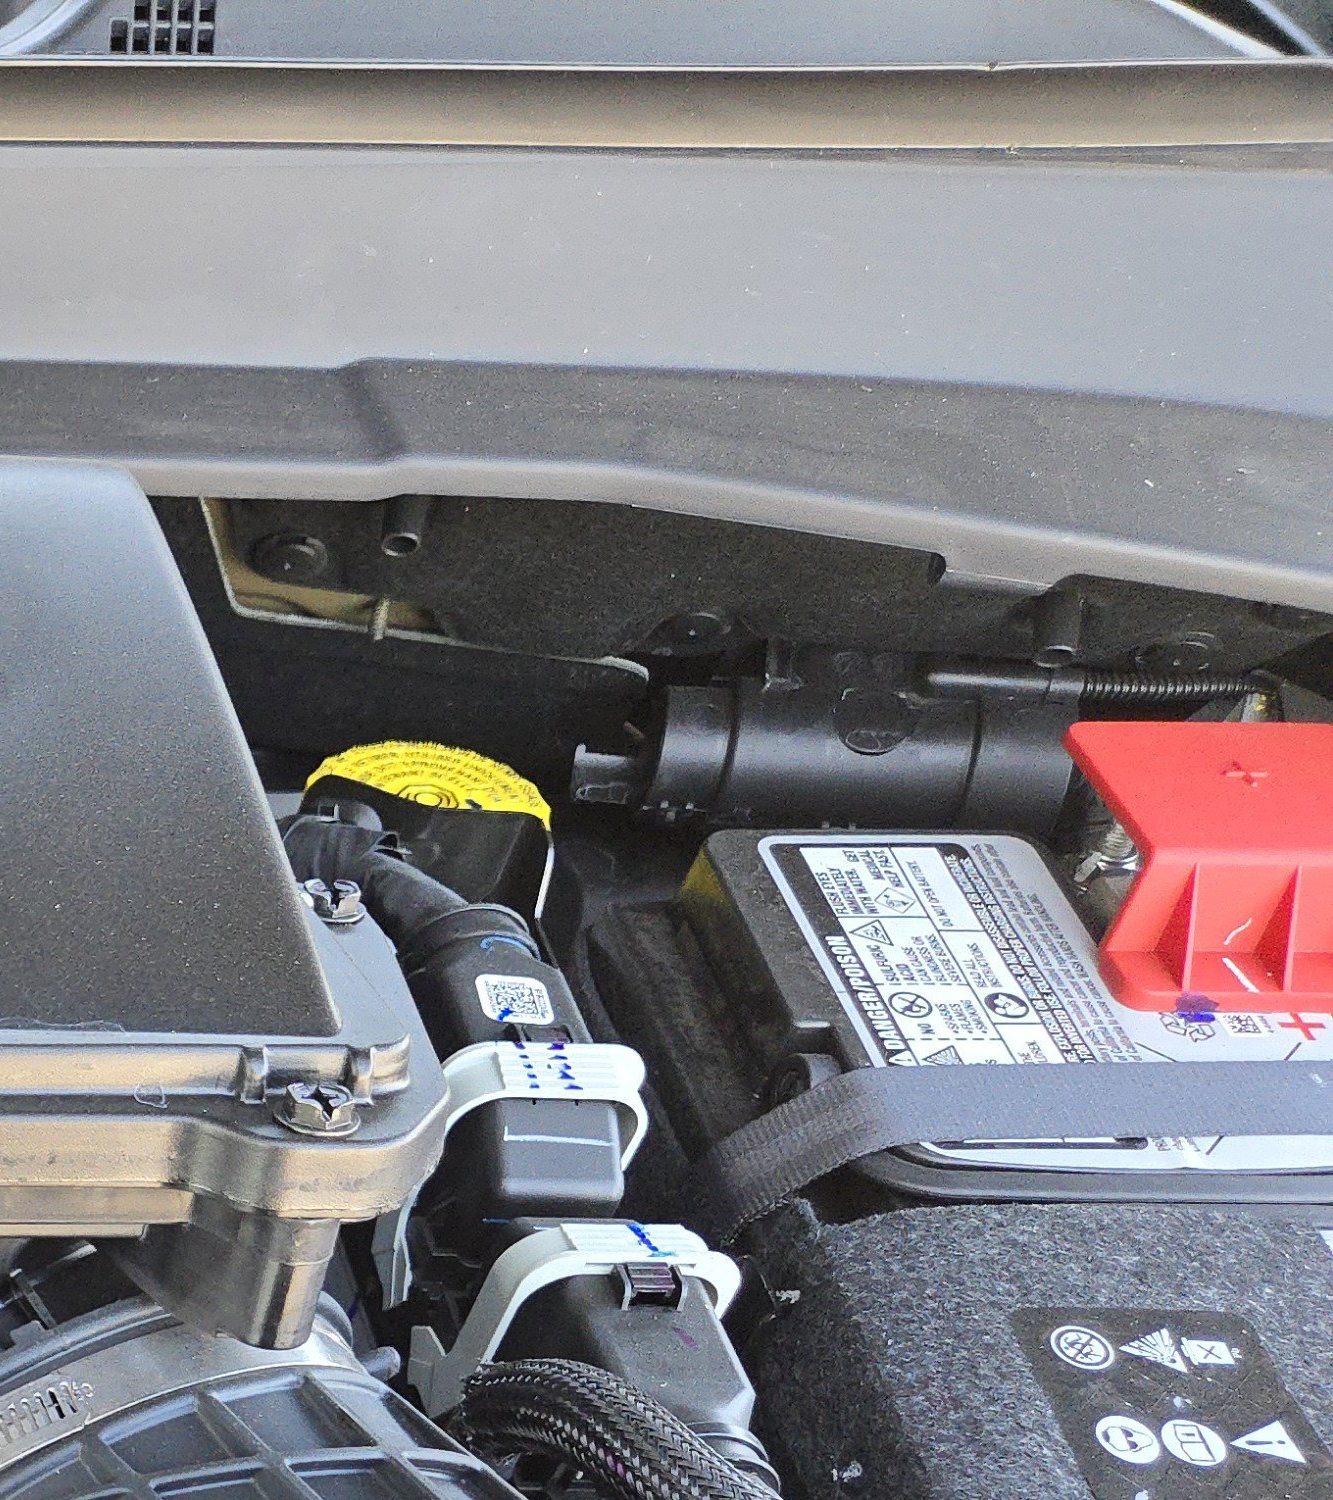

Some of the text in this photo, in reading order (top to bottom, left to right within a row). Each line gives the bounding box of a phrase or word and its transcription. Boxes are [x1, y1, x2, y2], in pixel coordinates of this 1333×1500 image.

[844, 850, 858, 862] GET
[862, 850, 884, 881] MEDICAL
[885, 870, 904, 888] HELP
[816, 871, 849, 914] FLUSH EYES
[827, 867, 864, 914] IMMEDIATELY
[923, 888, 939, 903] OPEN
[859, 896, 880, 914] WITH
[931, 906, 949, 916] NOT
[941, 918, 954, 927] DO
[868, 945, 900, 981] SULFURIC
[901, 946, 931, 982] CAN CAUSE
[912, 936, 948, 982] BLINDNESS OR
[1001, 949, 1018, 964] NOT
[895, 963, 916, 982] ACID
[940, 959, 962, 983] SEVERE
[962, 958, 987, 988] READ ALL
[825, 936, 907, 1050] DANGER/POISON
[1031, 1000, 1046, 1010] OR
[917, 1023, 935, 1035] NO
[1038, 1011, 1071, 1050] EXPLOSION
[1074, 1044, 1091, 1058] FOR
